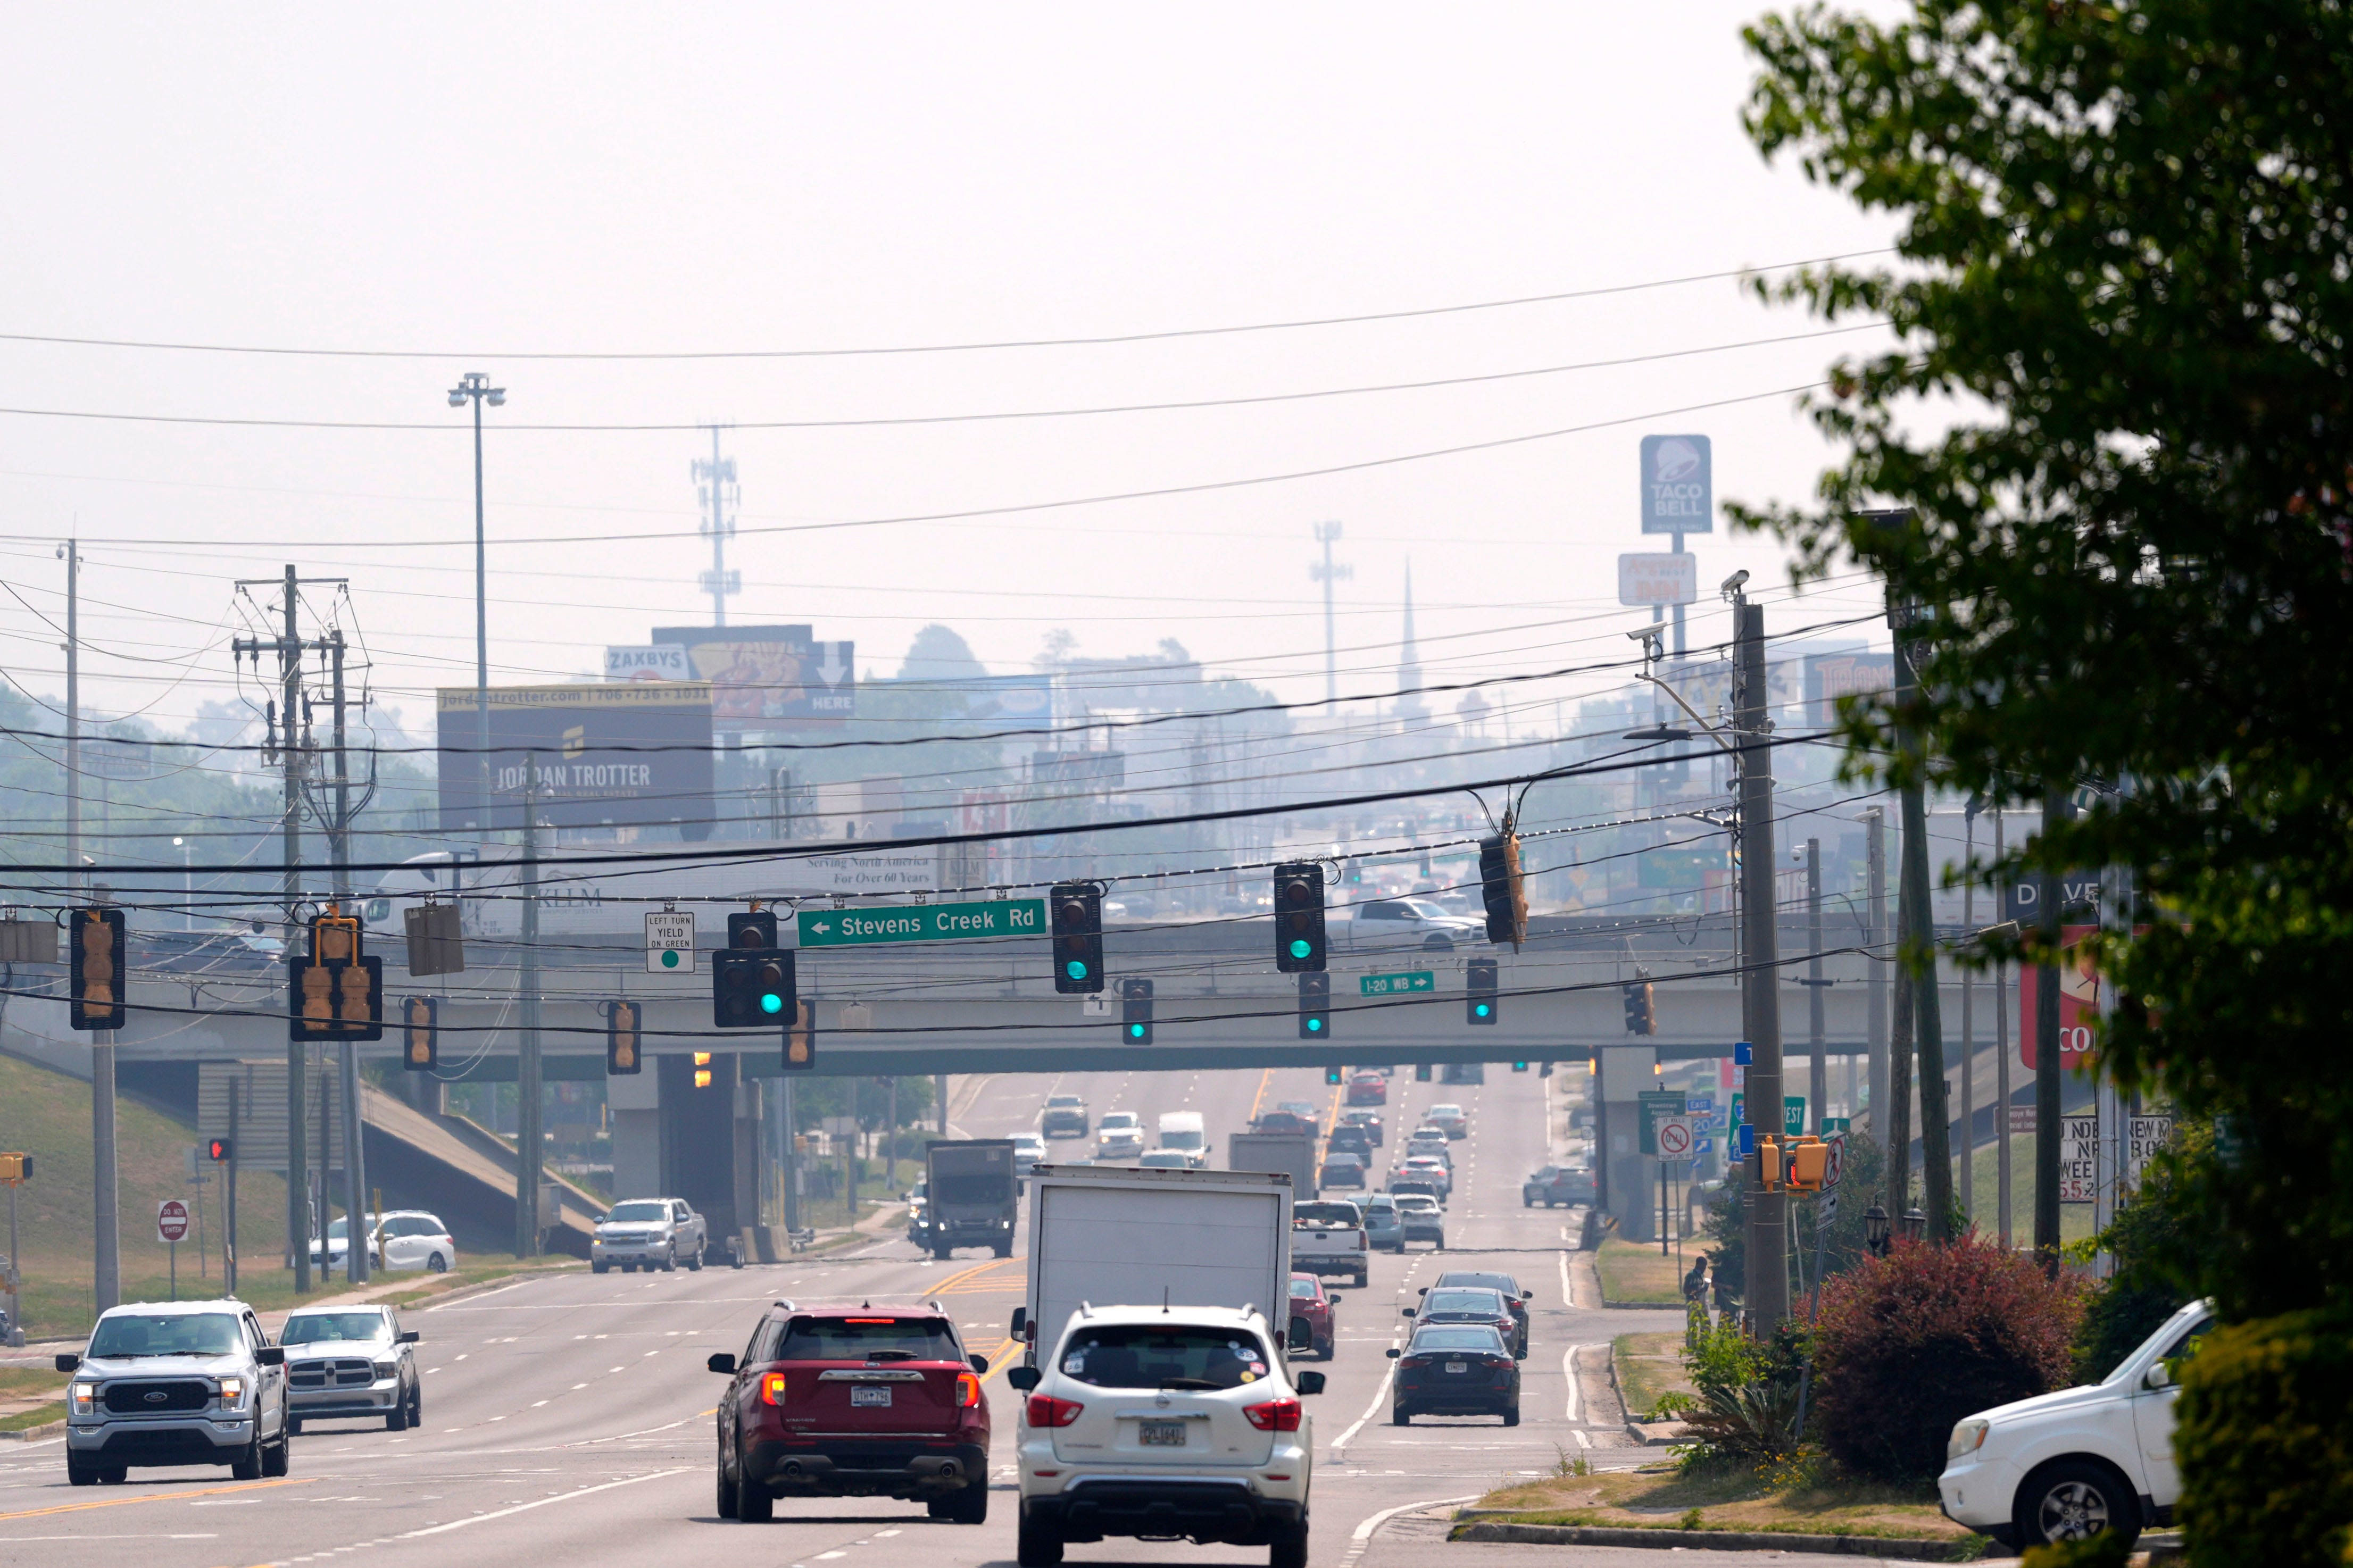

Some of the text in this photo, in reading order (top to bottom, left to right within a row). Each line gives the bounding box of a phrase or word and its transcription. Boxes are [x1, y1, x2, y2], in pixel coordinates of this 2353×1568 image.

[1651, 483, 1702, 499] TACO
[1655, 500, 1702, 516] BELL
[1636, 580, 1680, 602] INN
[610, 650, 682, 669] ZAXBYS
[812, 696, 852, 710] HERE
[497, 764, 650, 789] JORDAN TROTTER
[807, 855, 929, 869] Serving North America
[834, 872, 929, 884] For Over 60 Years
[537, 888, 602, 907] KLLM
[2017, 882, 2100, 905] DIVE
[842, 908, 1034, 936] Stevens Creek Rd
[658, 928, 683, 937] YIELD
[1367, 978, 1409, 992] I-20 WB
[1784, 1106, 1802, 1124] EST
[1693, 1119, 1710, 1132] 20
